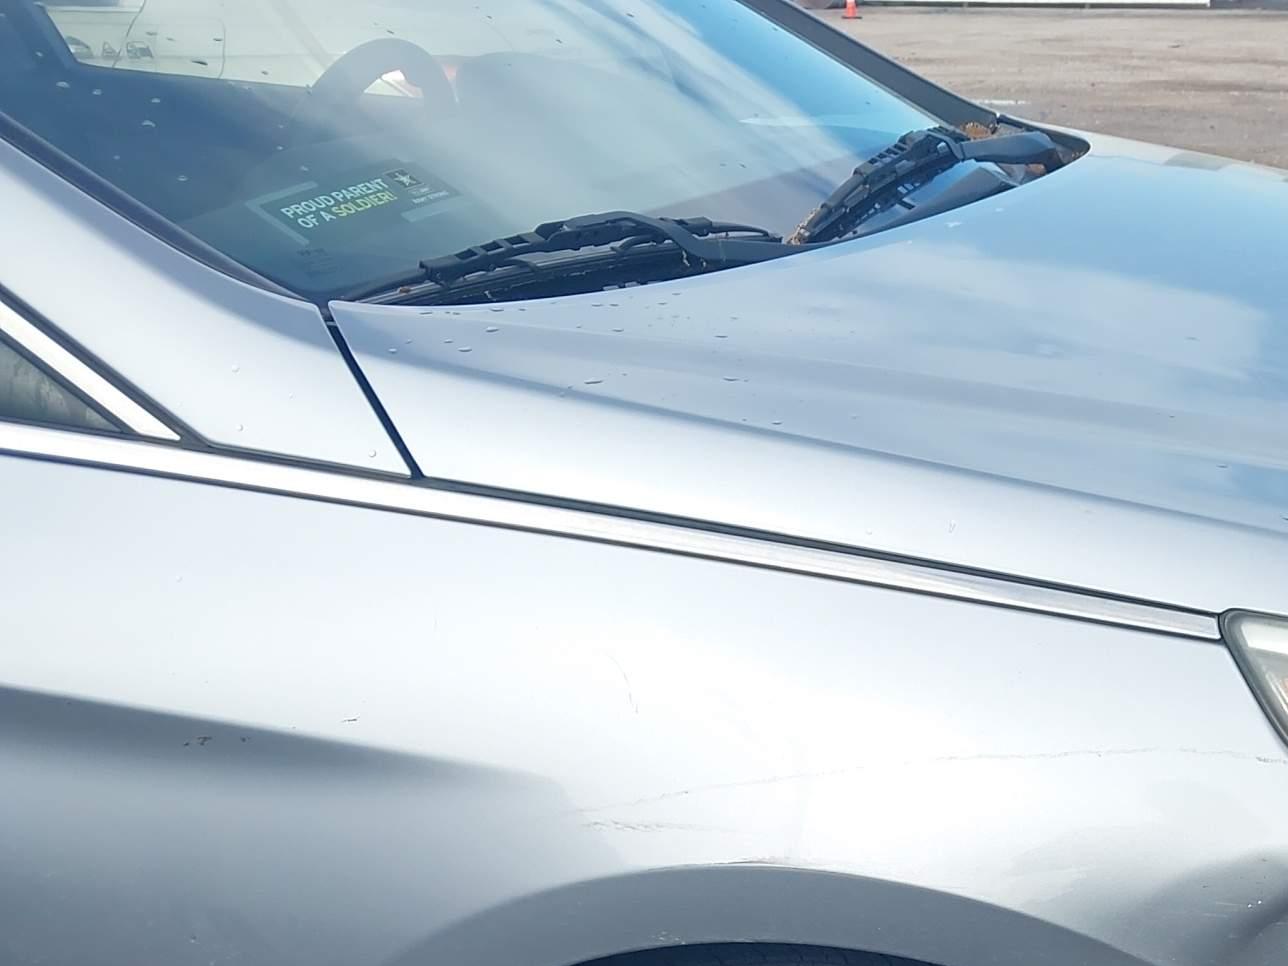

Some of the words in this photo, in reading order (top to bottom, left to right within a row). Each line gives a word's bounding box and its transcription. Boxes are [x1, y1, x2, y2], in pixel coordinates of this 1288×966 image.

[281, 194, 335, 218] PROUD
[333, 178, 389, 203] PARENT
[296, 214, 319, 229] OF
[324, 209, 338, 222] A
[331, 191, 397, 217] SOLDIER!
